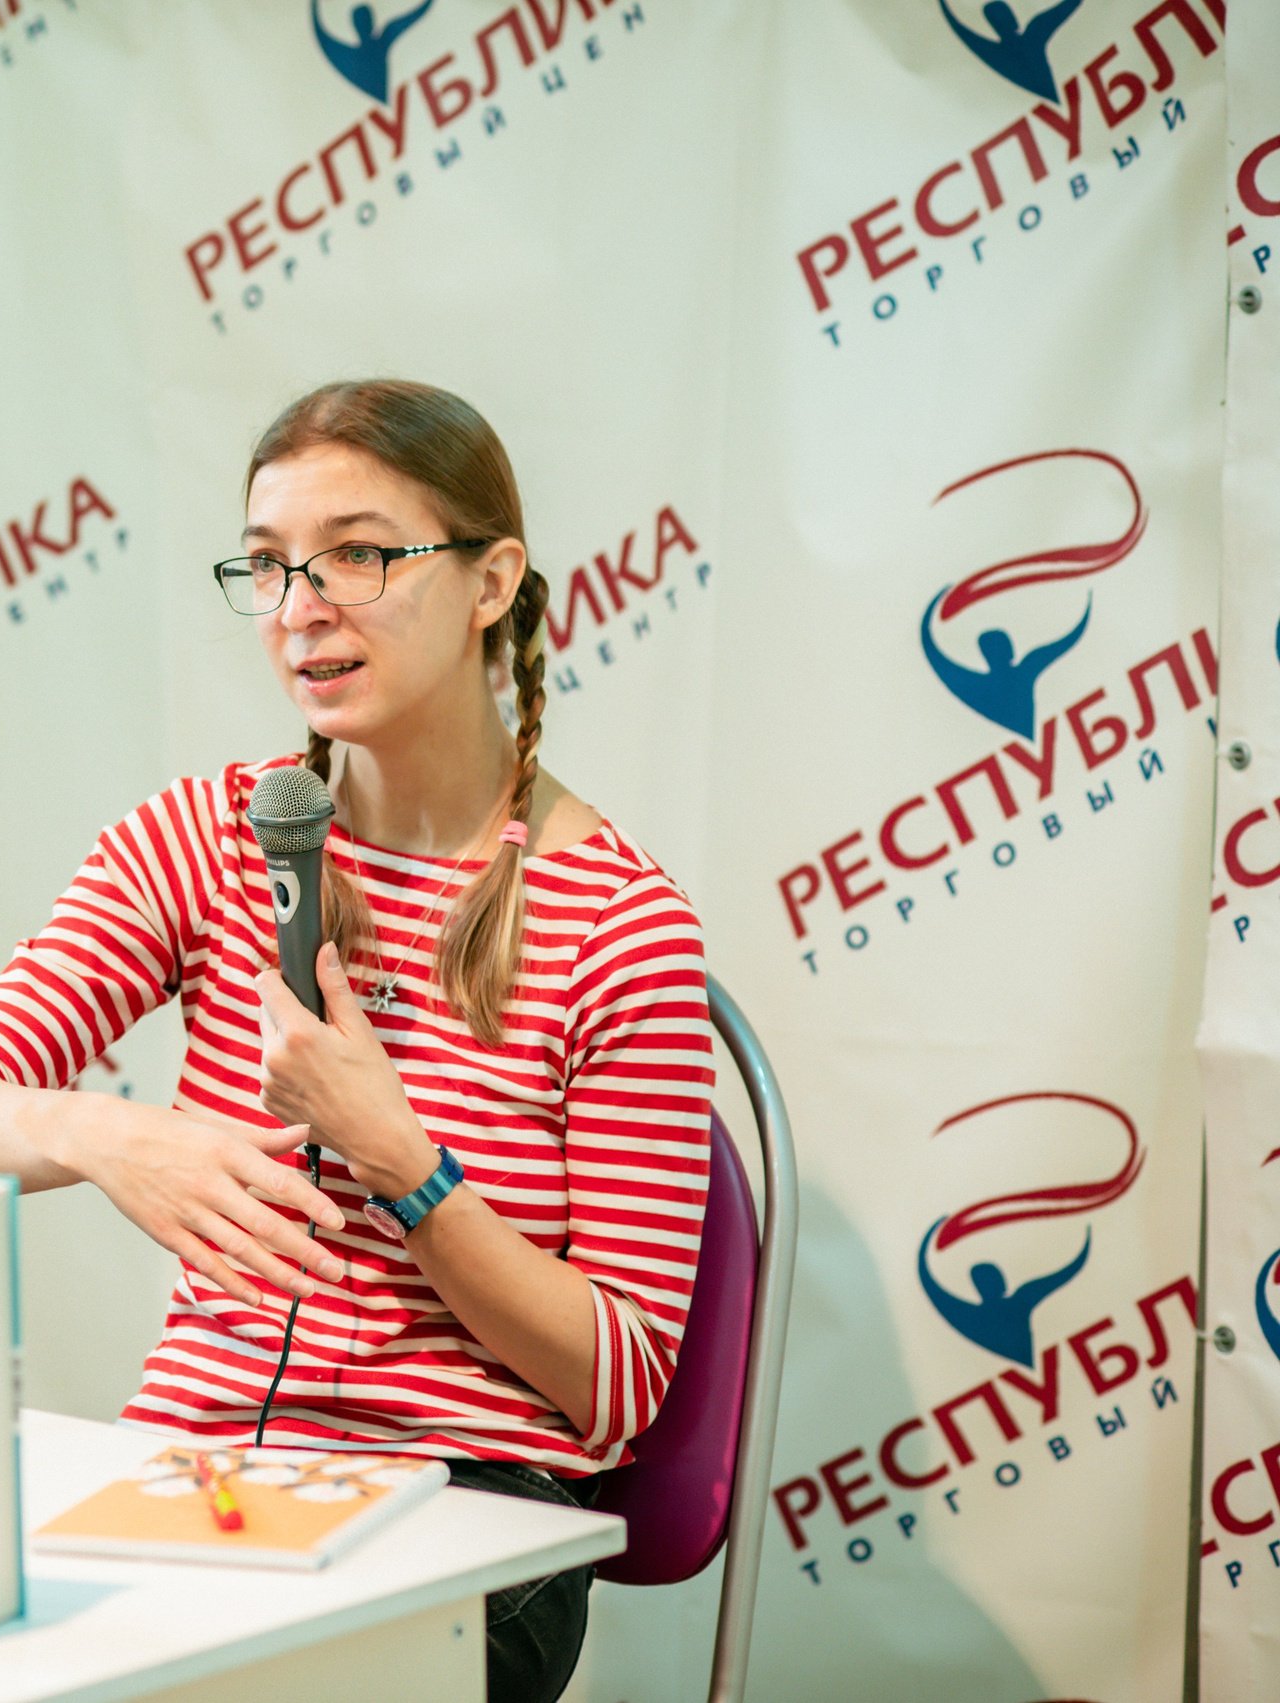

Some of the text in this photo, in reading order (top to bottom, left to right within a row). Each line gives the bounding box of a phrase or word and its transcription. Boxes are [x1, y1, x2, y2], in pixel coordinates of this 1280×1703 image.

[185, 0, 616, 303] РЕСПУБЛИ
[211, 105, 506, 336] ТОРГОВЫЙ
[795, 0, 1226, 314] РЕСПУБЛ
[822, 97, 1186, 349] ТОРГОВЫЙ
[554, 561, 711, 694] ЦЕНТР
[801, 748, 1164, 975] ТОРГОВЫЙ
[800, 1376, 1179, 1586] ТОРГОВЫЙ
